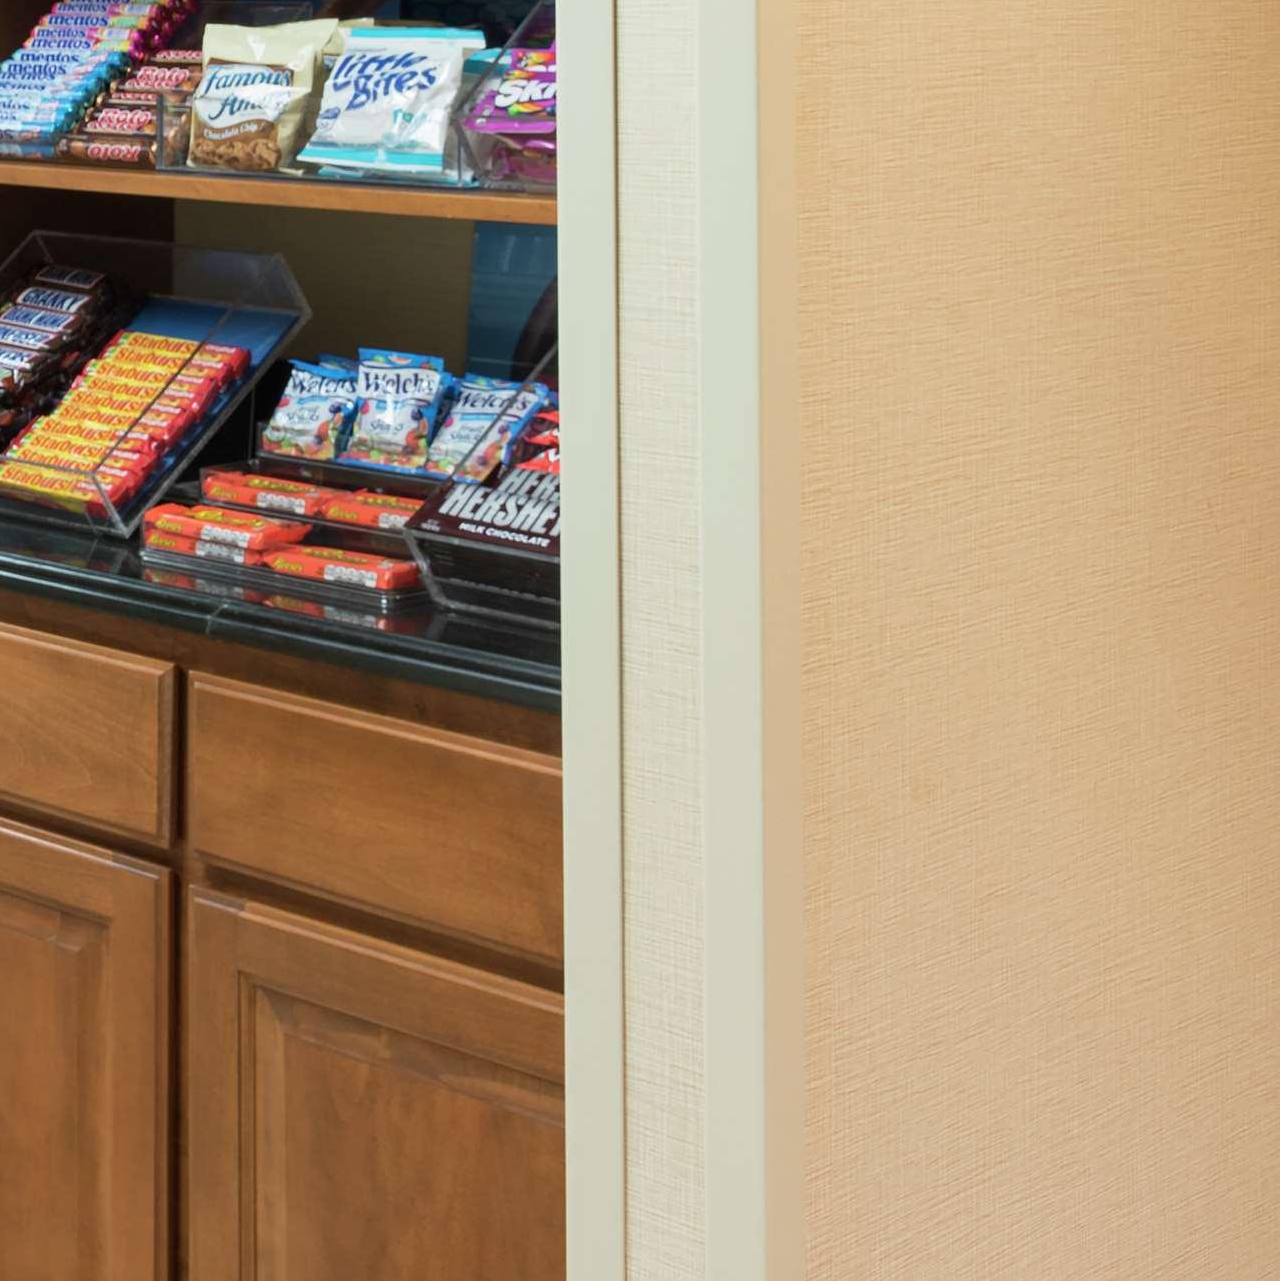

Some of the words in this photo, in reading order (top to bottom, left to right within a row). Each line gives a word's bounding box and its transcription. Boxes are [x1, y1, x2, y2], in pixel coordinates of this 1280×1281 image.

[48, 15, 109, 27] mentos
[36, 28, 86, 39] mentos
[31, 38, 92, 49] mentos
[20, 52, 80, 63] mentos
[7, 61, 67, 76] mentos
[129, 335, 198, 354] Starburs
[363, 371, 435, 395] Welch's
[458, 522, 485, 535] MILK
[486, 527, 551, 548] CHOCOLATE
